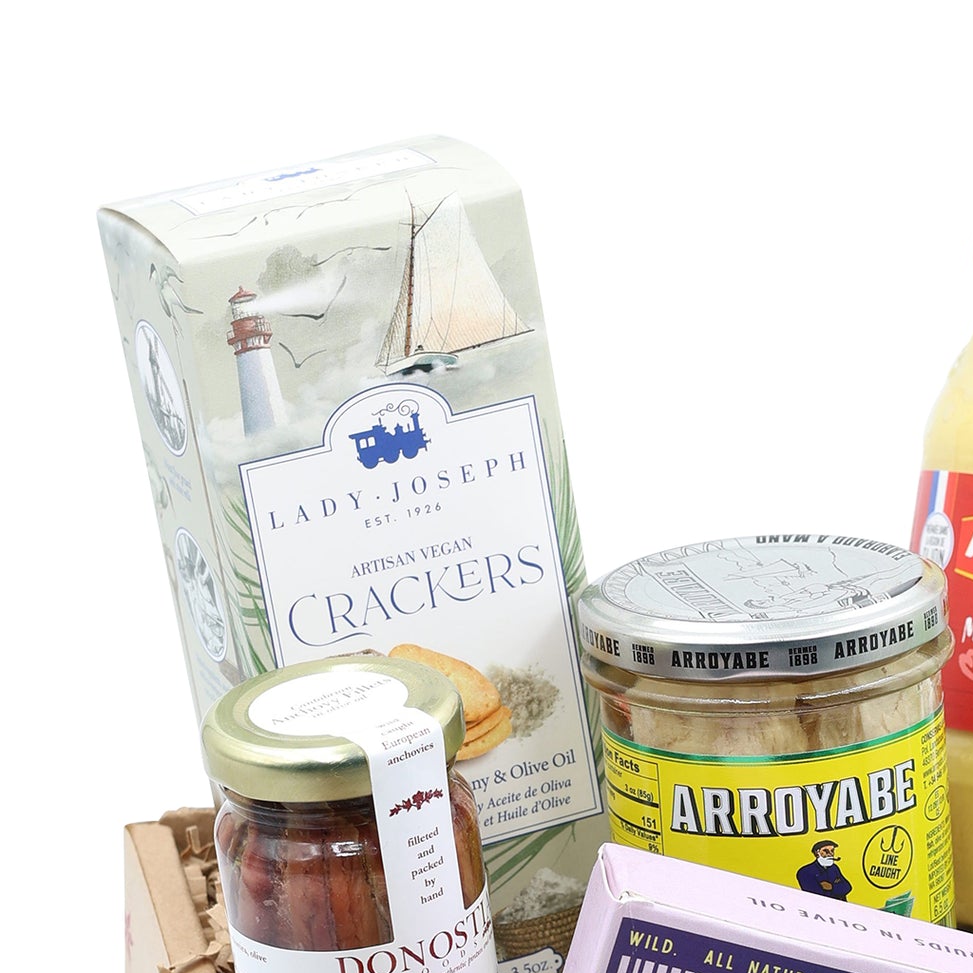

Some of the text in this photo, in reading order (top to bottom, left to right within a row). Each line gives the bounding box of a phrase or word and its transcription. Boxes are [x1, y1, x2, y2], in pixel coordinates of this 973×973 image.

[269, 451, 527, 530] LADY JOSEPH
[365, 502, 442, 529] EST. 1926
[351, 536, 473, 578] ARTISAN VEGAN
[288, 544, 544, 646] CRACKERS
[788, 645, 817, 655] BERMEO
[834, 620, 915, 660] ARROYABE
[632, 651, 656, 665] 1898
[671, 650, 770, 670] ARROYABE
[789, 653, 819, 667] 1898
[381, 727, 431, 750] European
[387, 741, 435, 765] anchovies
[614, 752, 640, 773] Facts
[494, 749, 576, 784] & Olive Oil
[487, 791, 521, 809] Aceite
[525, 786, 538, 799] de
[540, 778, 572, 795] Oliva
[671, 758, 917, 838] ARROYABE
[483, 795, 571, 827] et Huile d'Olive
[641, 816, 657, 830] 151
[407, 827, 439, 848] filleted
[417, 845, 435, 859] and
[880, 853, 899, 866] LINE
[411, 856, 444, 880] packed
[869, 864, 902, 880] CAUGHT
[424, 877, 436, 888] by
[421, 888, 444, 904] hand
[747, 896, 787, 914] OIL
[797, 906, 868, 931] OLIVE
[880, 926, 903, 941] IN
[250, 952, 267, 963] olive
[629, 930, 678, 957] WILD.
[702, 949, 735, 972] ALL
